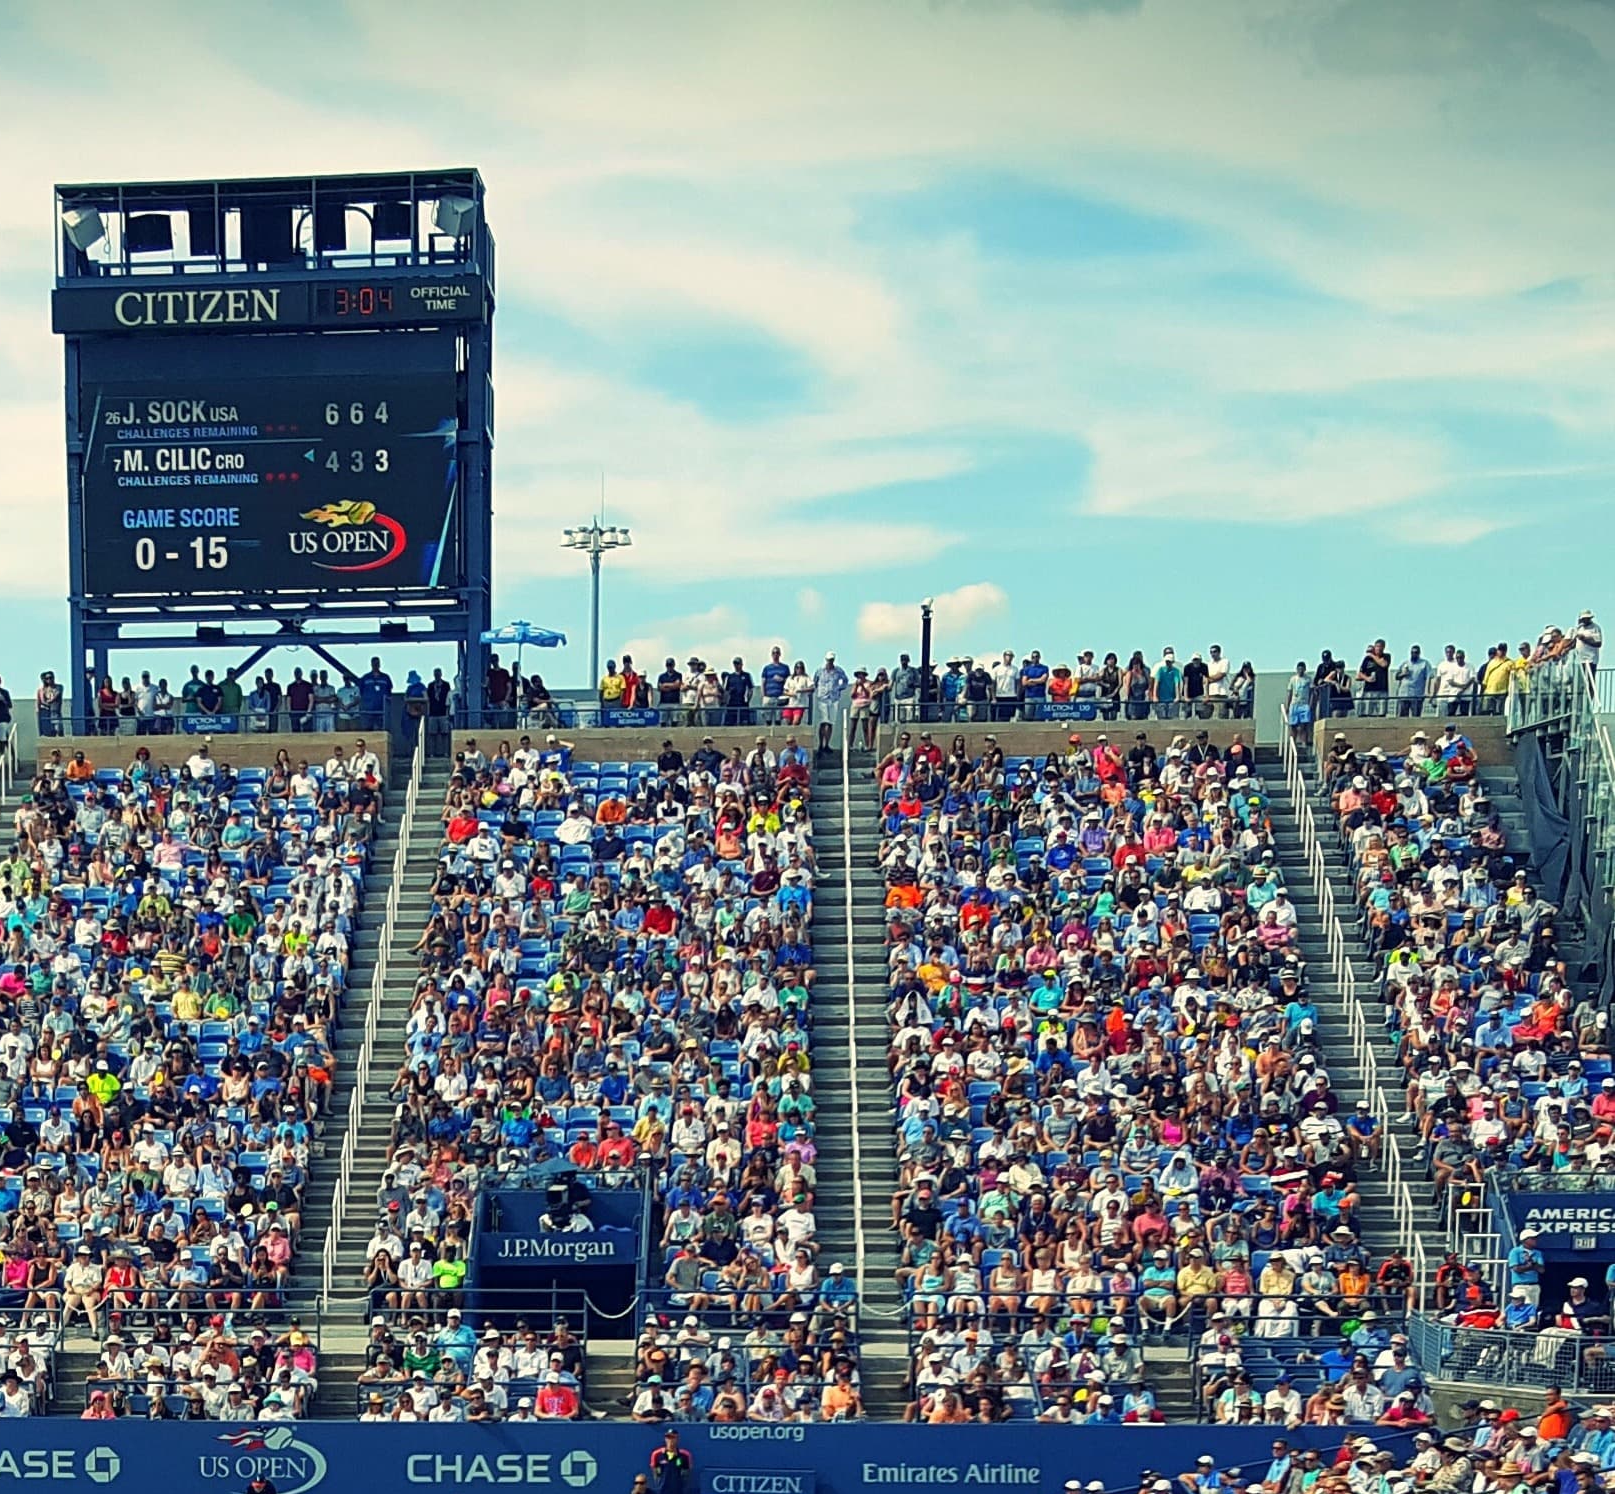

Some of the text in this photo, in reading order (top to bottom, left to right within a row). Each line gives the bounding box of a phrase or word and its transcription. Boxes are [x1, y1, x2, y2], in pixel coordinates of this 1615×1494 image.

[337, 289, 393, 315] 3:04
[410, 285, 471, 299] OFFICIAL
[114, 289, 280, 326] CITIZEN
[425, 299, 457, 311] TIME
[148, 400, 207, 424] SOCK
[210, 406, 239, 422] USA
[325, 401, 389, 425] 6 6 4
[117, 425, 258, 440] CHALLENGES REMAINING
[123, 449, 150, 472] M.
[155, 448, 212, 472] CILIC
[215, 454, 245, 471] CRO
[325, 449, 389, 473] 4 3 3
[117, 473, 259, 487] CHALLENGES REMAINING
[123, 507, 240, 529] GAME SCORE
[135, 537, 156, 570] 0
[189, 536, 228, 569] 15
[289, 530, 390, 554] US OPEN
[1526, 1208, 1615, 1220] AMERIC
[498, 1239, 614, 1262] J.P.Morgan
[709, 1425, 805, 1442] usopen.org
[198, 1456, 308, 1479] US OPEN
[406, 1453, 552, 1483] CHASE
[862, 1463, 1041, 1484] Emirates Airline
[712, 1474, 803, 1494] CITIZEN
